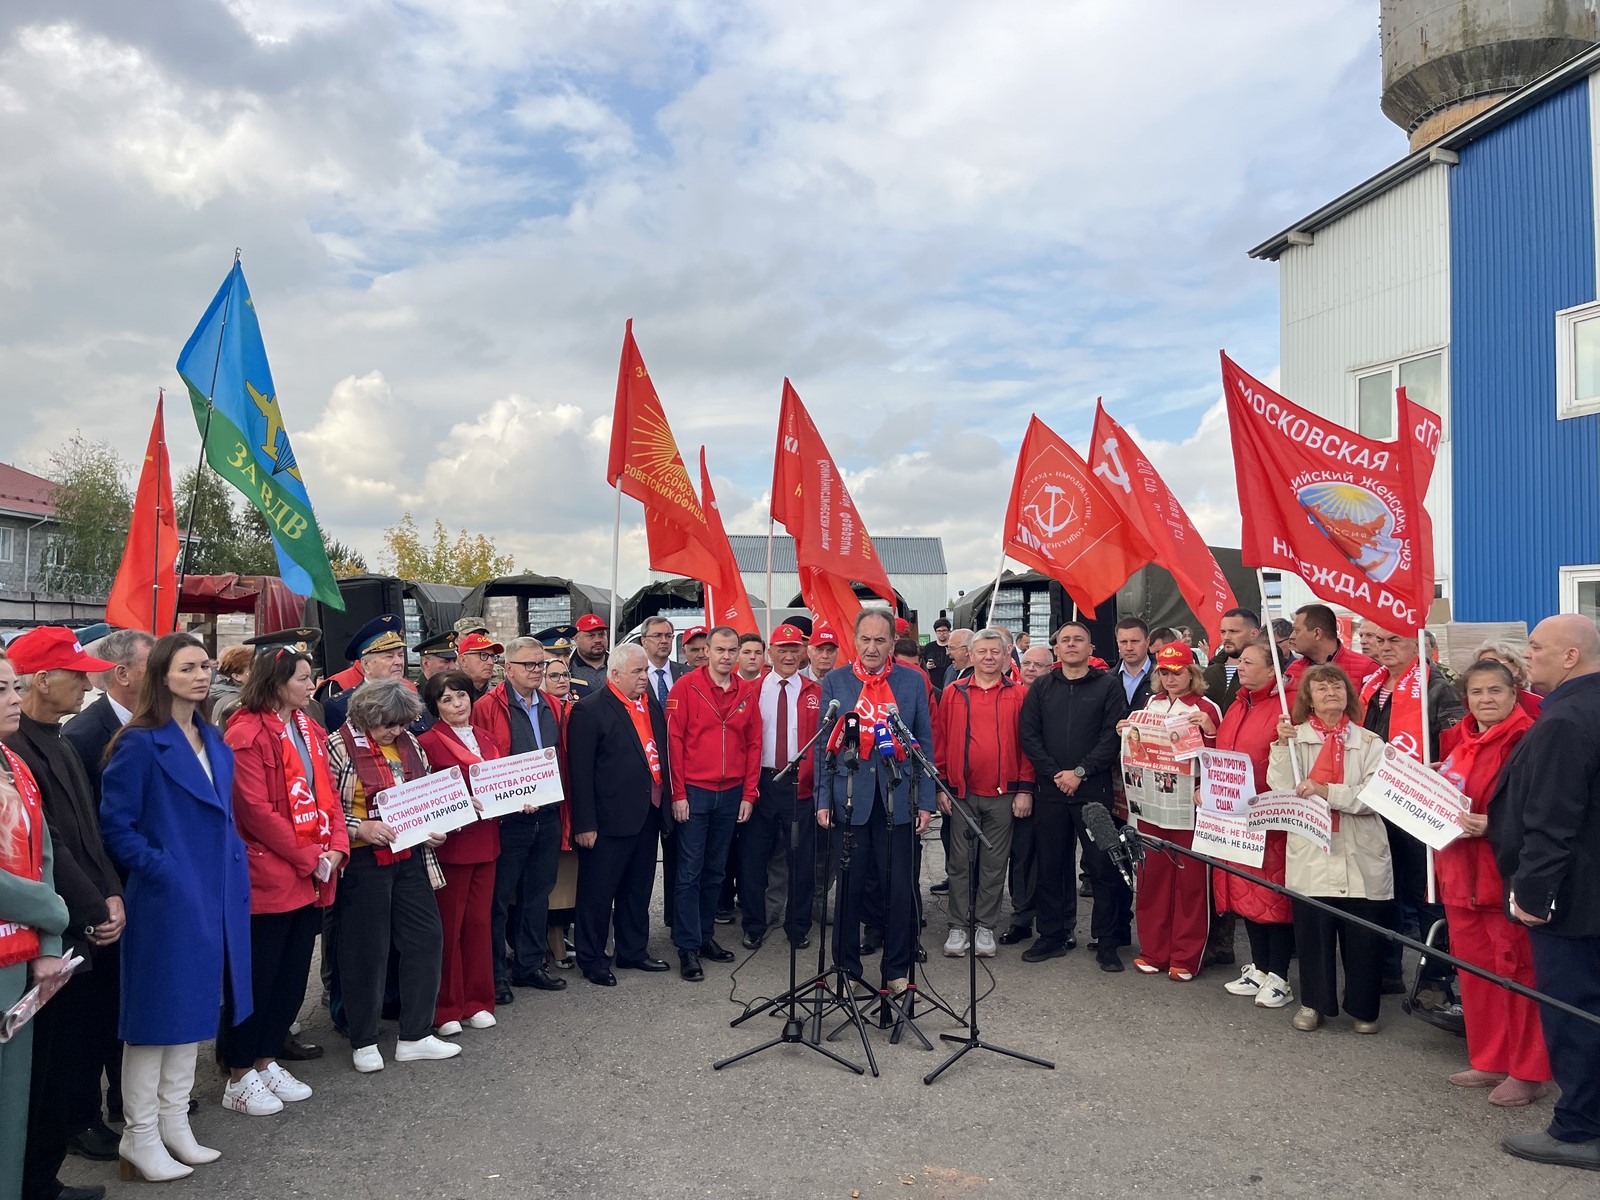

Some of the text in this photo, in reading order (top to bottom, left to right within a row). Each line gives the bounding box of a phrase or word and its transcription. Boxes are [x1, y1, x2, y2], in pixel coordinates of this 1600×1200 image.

[1238, 379, 1389, 471] МОСКОВСКАЯ
[226, 441, 308, 540] ЗА ВДВ
[624, 464, 674, 502] СОВЕТСКИХ
[664, 473, 693, 496] СОЮЗ
[1325, 525, 1367, 539] ОССИЯ
[1273, 537, 1371, 602] НАЕЖДА
[859, 725, 875, 733] ПРФ
[1212, 756, 1247, 772] МЫ ПРОТИВ
[474, 778, 519, 795] БОГАТСТВА
[520, 769, 555, 784] РОССИИ
[1208, 769, 1246, 786] АГРЕССИВНОЙ
[1377, 768, 1436, 809] СПРАВЕДЛИВЫЕ
[494, 784, 537, 801] НАРОДУ
[1210, 784, 1241, 800] ПОЛИТИКИ
[387, 802, 430, 823] ОСТАНОВИМ
[431, 795, 448, 808] РОСТ
[448, 789, 466, 802] ЦЕН,
[392, 799, 469, 835] ДОЛГОВ И ТАРИФОВ
[1216, 799, 1234, 811] США!
[1384, 789, 1445, 831] А НЕ ПОДАЧКИ
[1197, 820, 1225, 834] ЗДОРОВЬЕ
[1230, 829, 1240, 838] НЕ
[1241, 830, 1264, 843] ТОВАР,
[1248, 817, 1280, 827] РАБОЧИЕ
[1281, 817, 1303, 828] МЕСТА
[1309, 825, 1331, 846] РАЗВИТ
[1249, 808, 1295, 819] ГОРОДАМ
[1305, 813, 1328, 832] СЕЛАМ
[1195, 830, 1227, 845] МЕДИЦИНА
[1231, 839, 1241, 848] НЕ
[1242, 841, 1264, 853] БАЗАР
